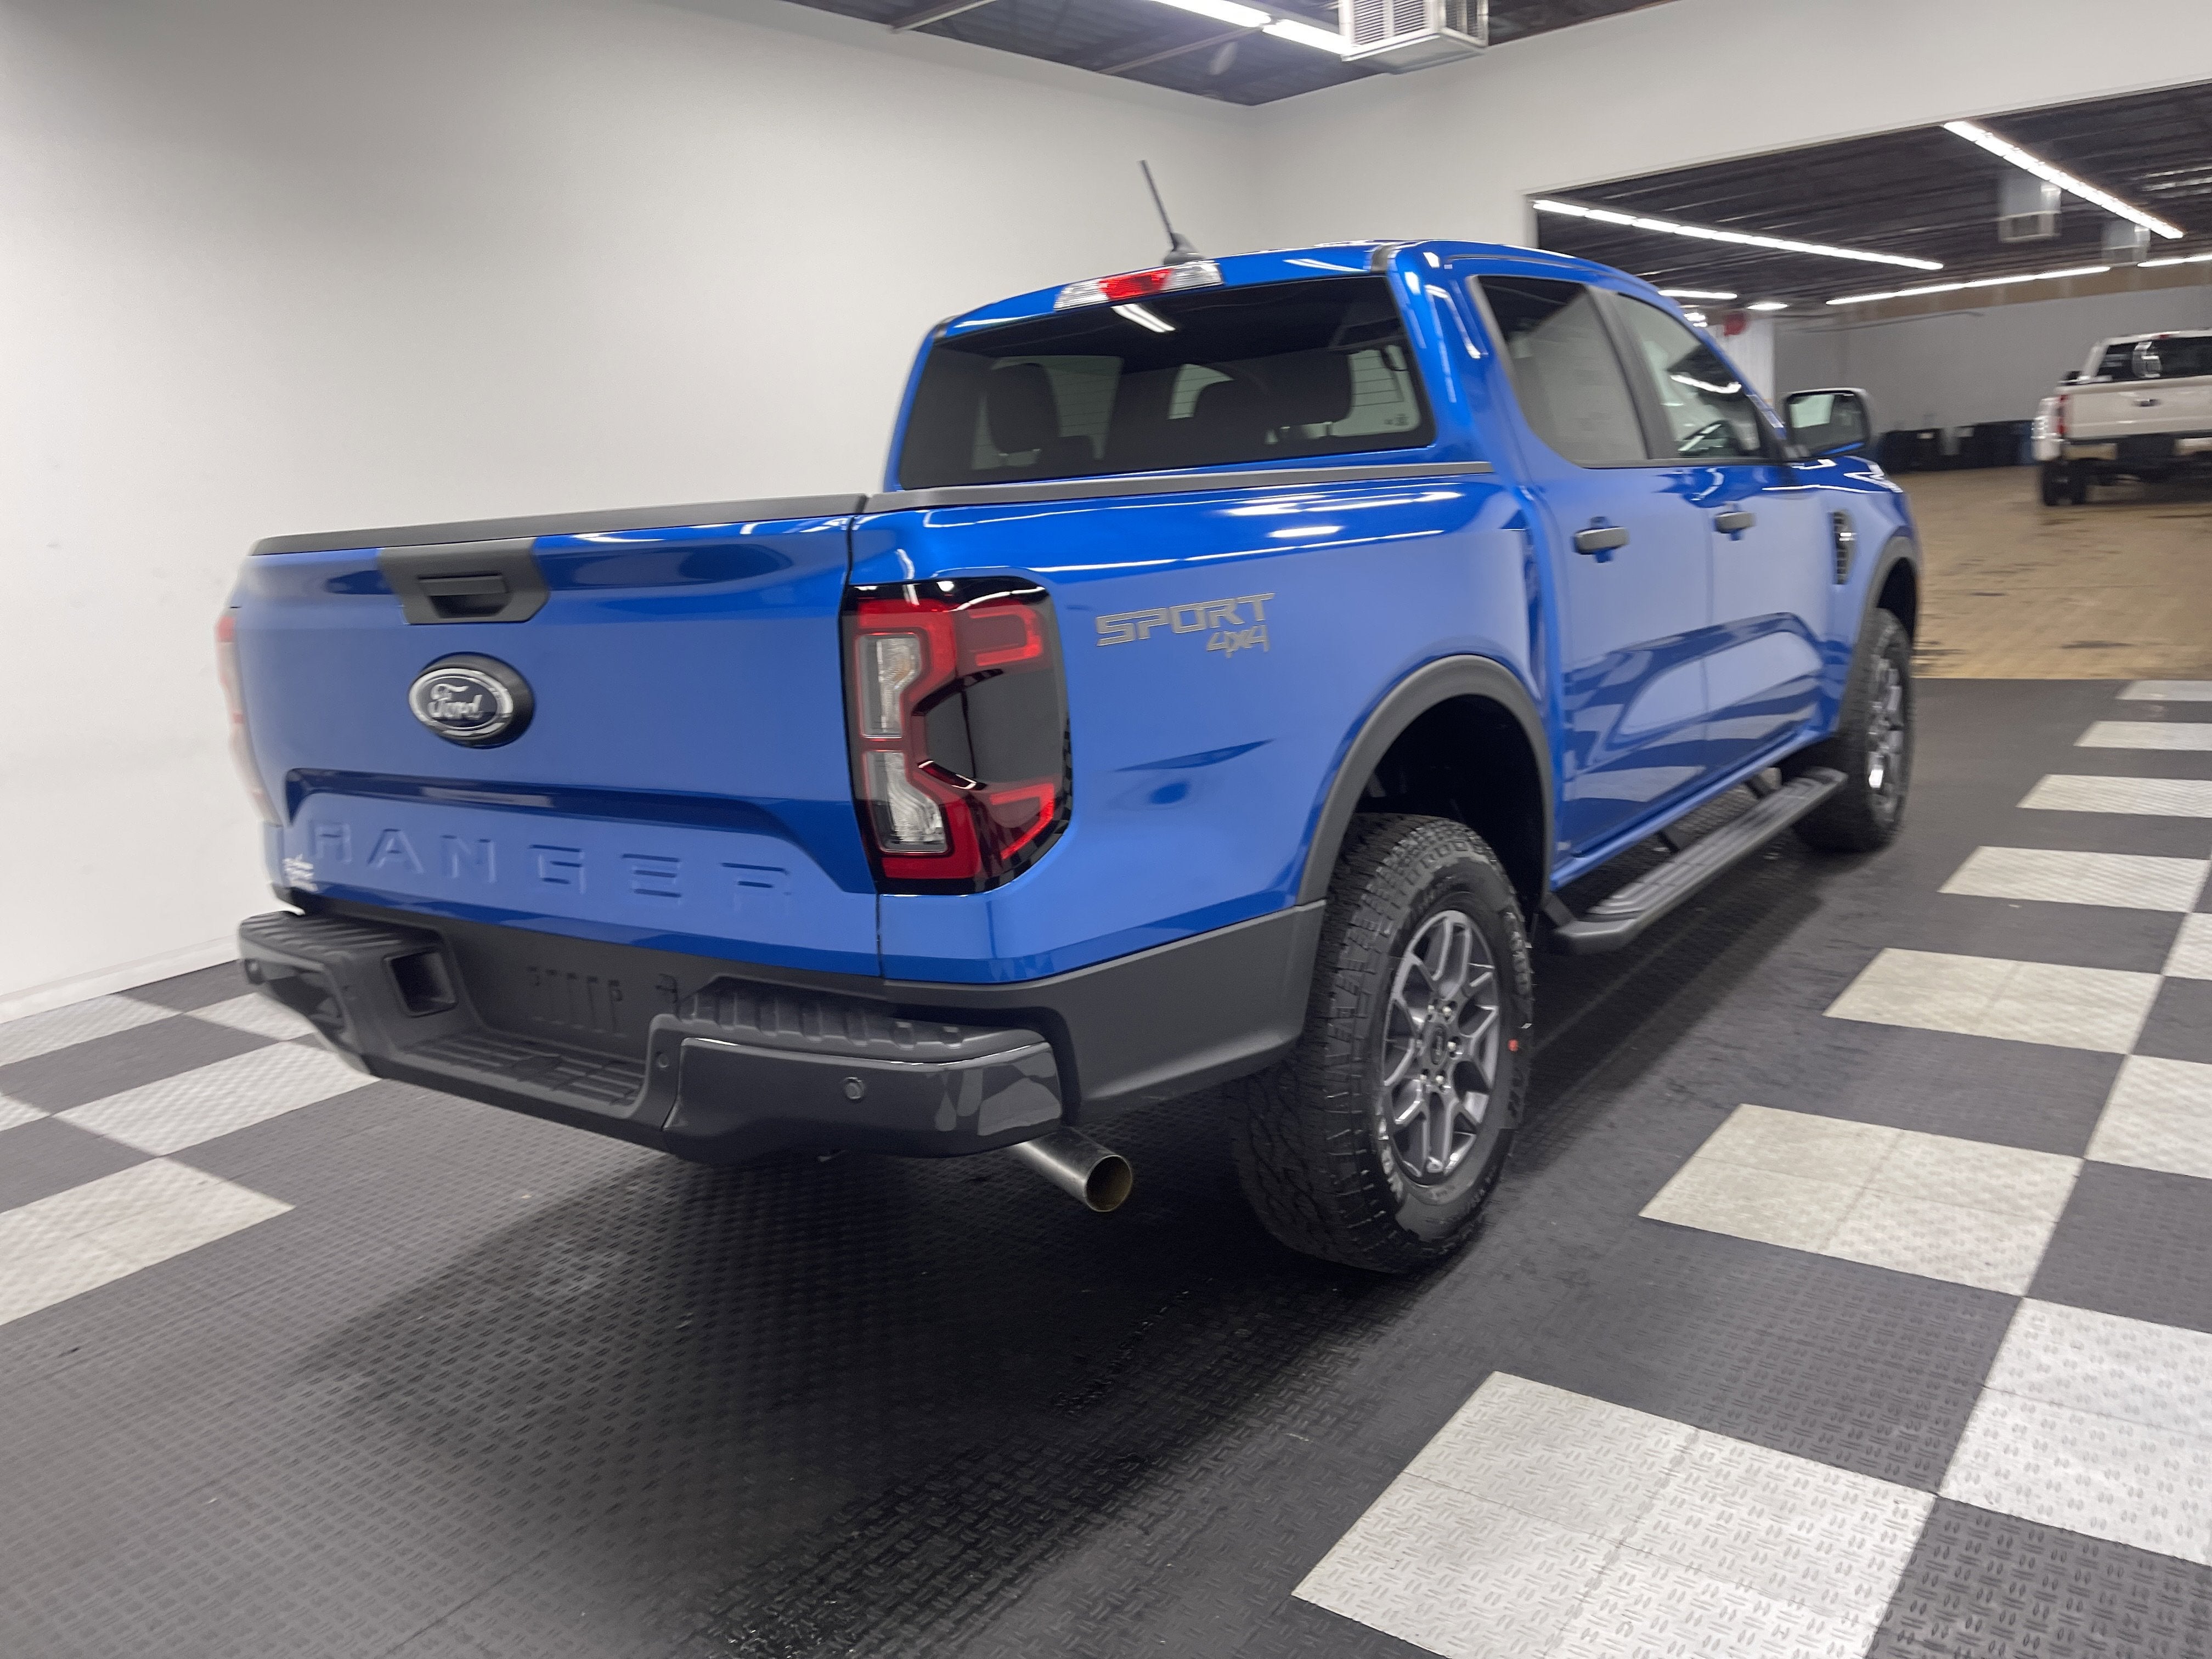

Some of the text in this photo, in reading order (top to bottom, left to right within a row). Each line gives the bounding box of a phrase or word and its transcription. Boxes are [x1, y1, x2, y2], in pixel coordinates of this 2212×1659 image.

[1096, 592, 1276, 647] SPORT
[427, 683, 483, 720] Ford
[307, 821, 791, 917] RANGER
